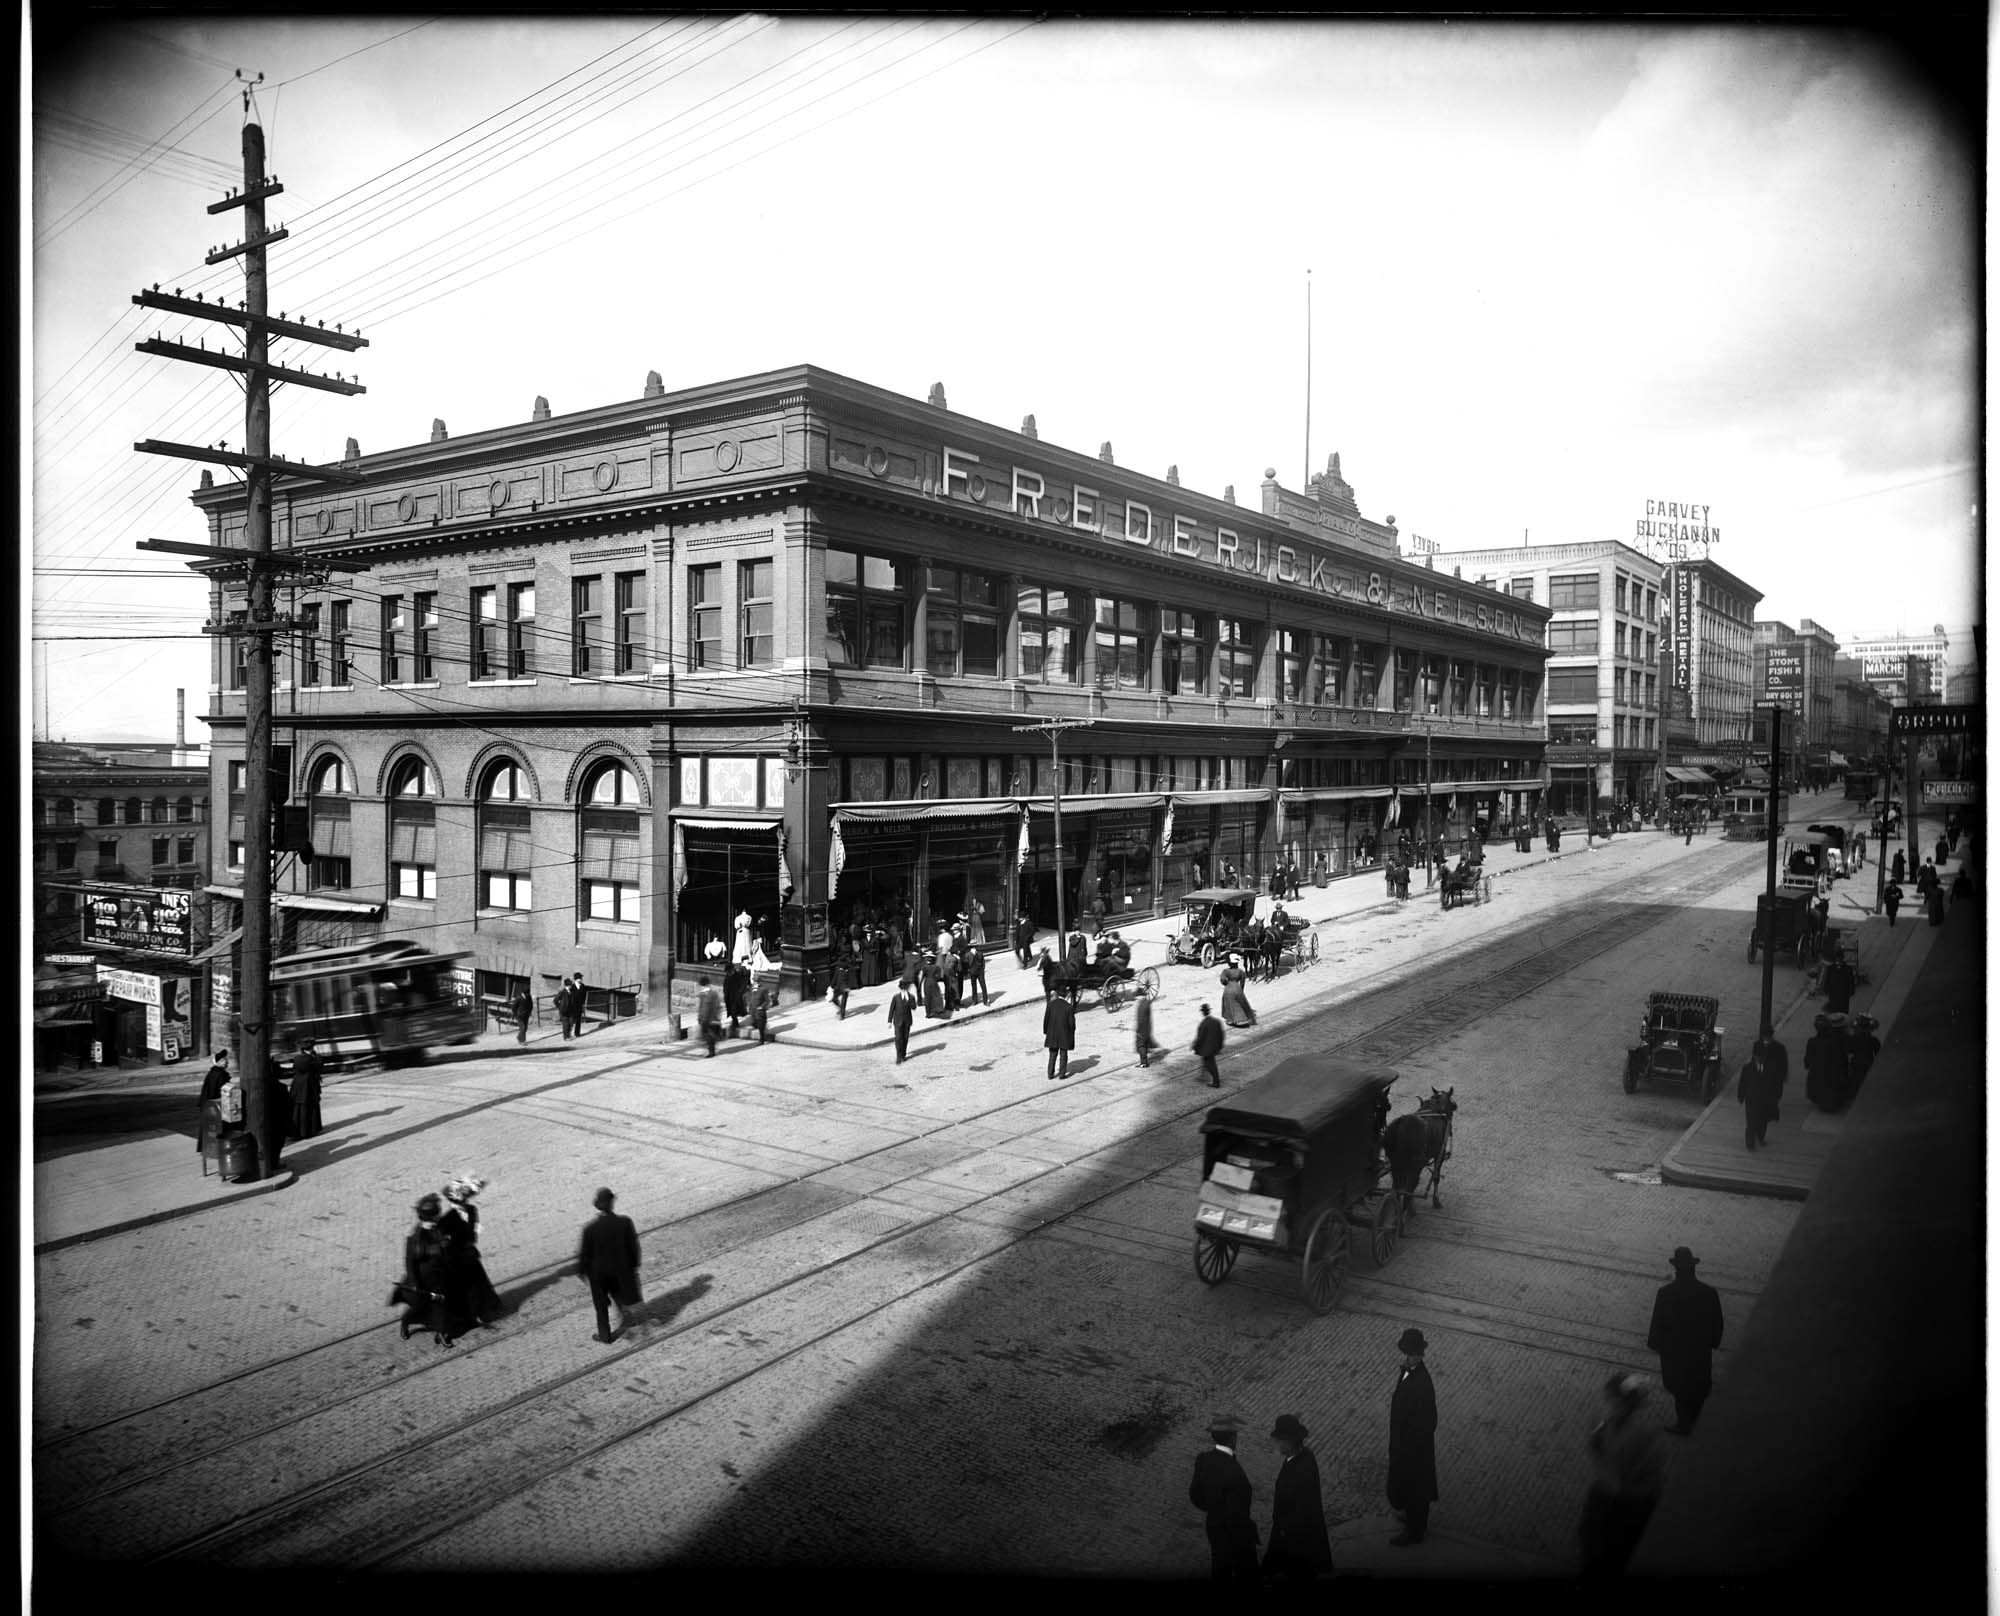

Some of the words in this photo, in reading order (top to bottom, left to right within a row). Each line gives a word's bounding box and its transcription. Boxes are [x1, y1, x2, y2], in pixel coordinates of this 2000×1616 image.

[1647, 499, 1710, 520] GARVEY
[942, 446, 1327, 592] FREDERICK
[1367, 572, 1384, 605] &
[1412, 584, 1522, 640] NELSON
[1678, 570, 1688, 635] WHOLESALE
[1769, 649, 1788, 657] THE
[1768, 657, 1800, 666] STONE
[1866, 662, 1904, 675] MARCHE
[1768, 676, 1782, 685] CO.
